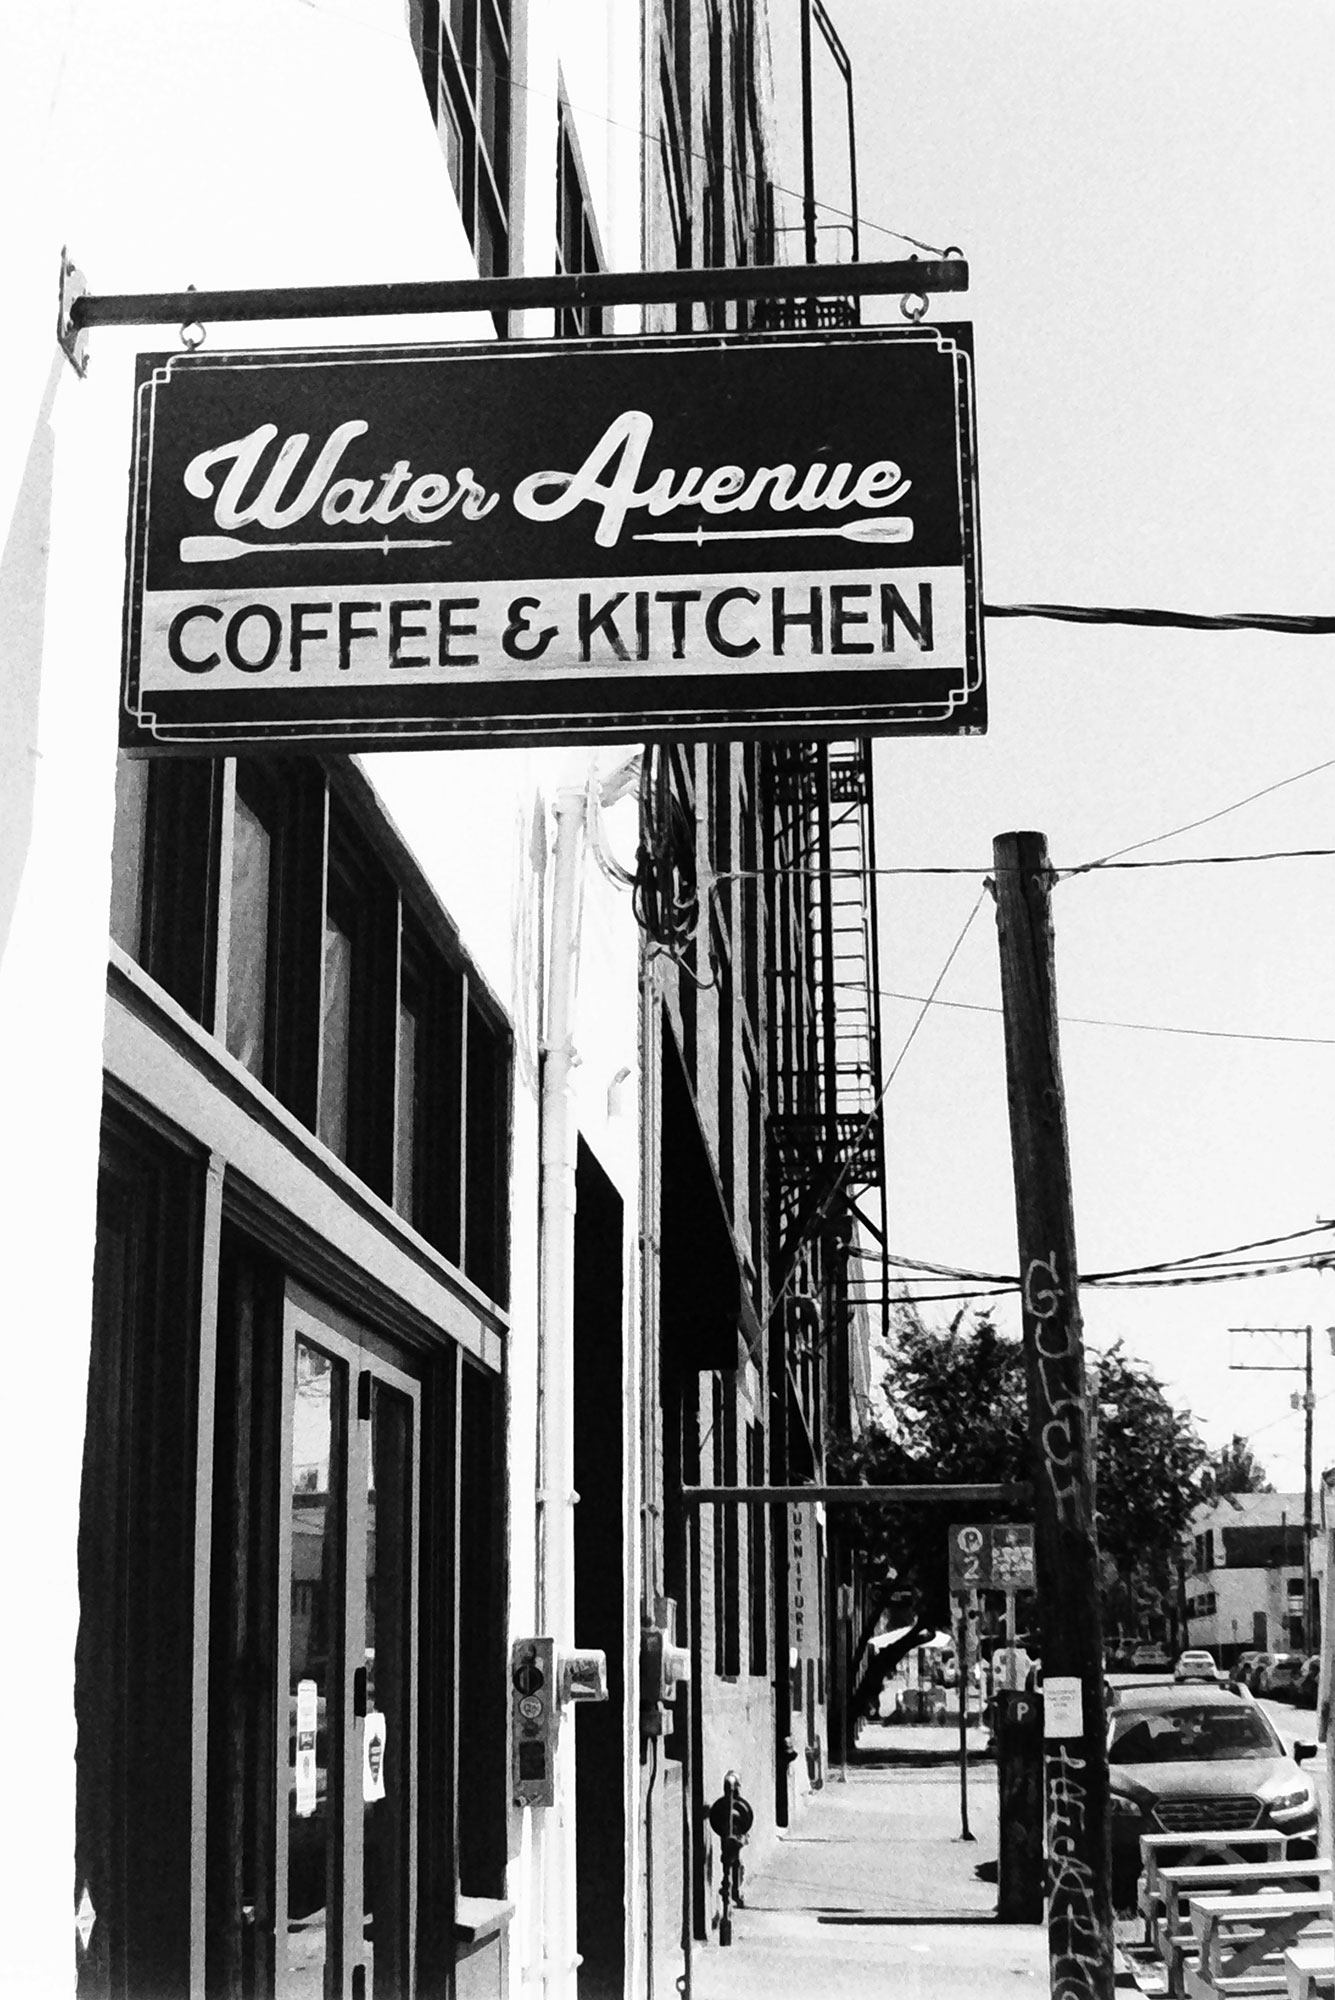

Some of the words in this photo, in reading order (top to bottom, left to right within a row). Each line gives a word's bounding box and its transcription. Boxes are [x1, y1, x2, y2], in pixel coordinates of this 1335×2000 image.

[183, 419, 500, 531] Water
[513, 410, 914, 549] Avenue
[168, 597, 481, 674] COFFEE
[502, 596, 558, 662] &
[578, 583, 934, 662] KITCHEN
[793, 1501, 804, 1642] URNITURE
[964, 1556, 979, 1579] 2
[1017, 1702, 1029, 1720] P
